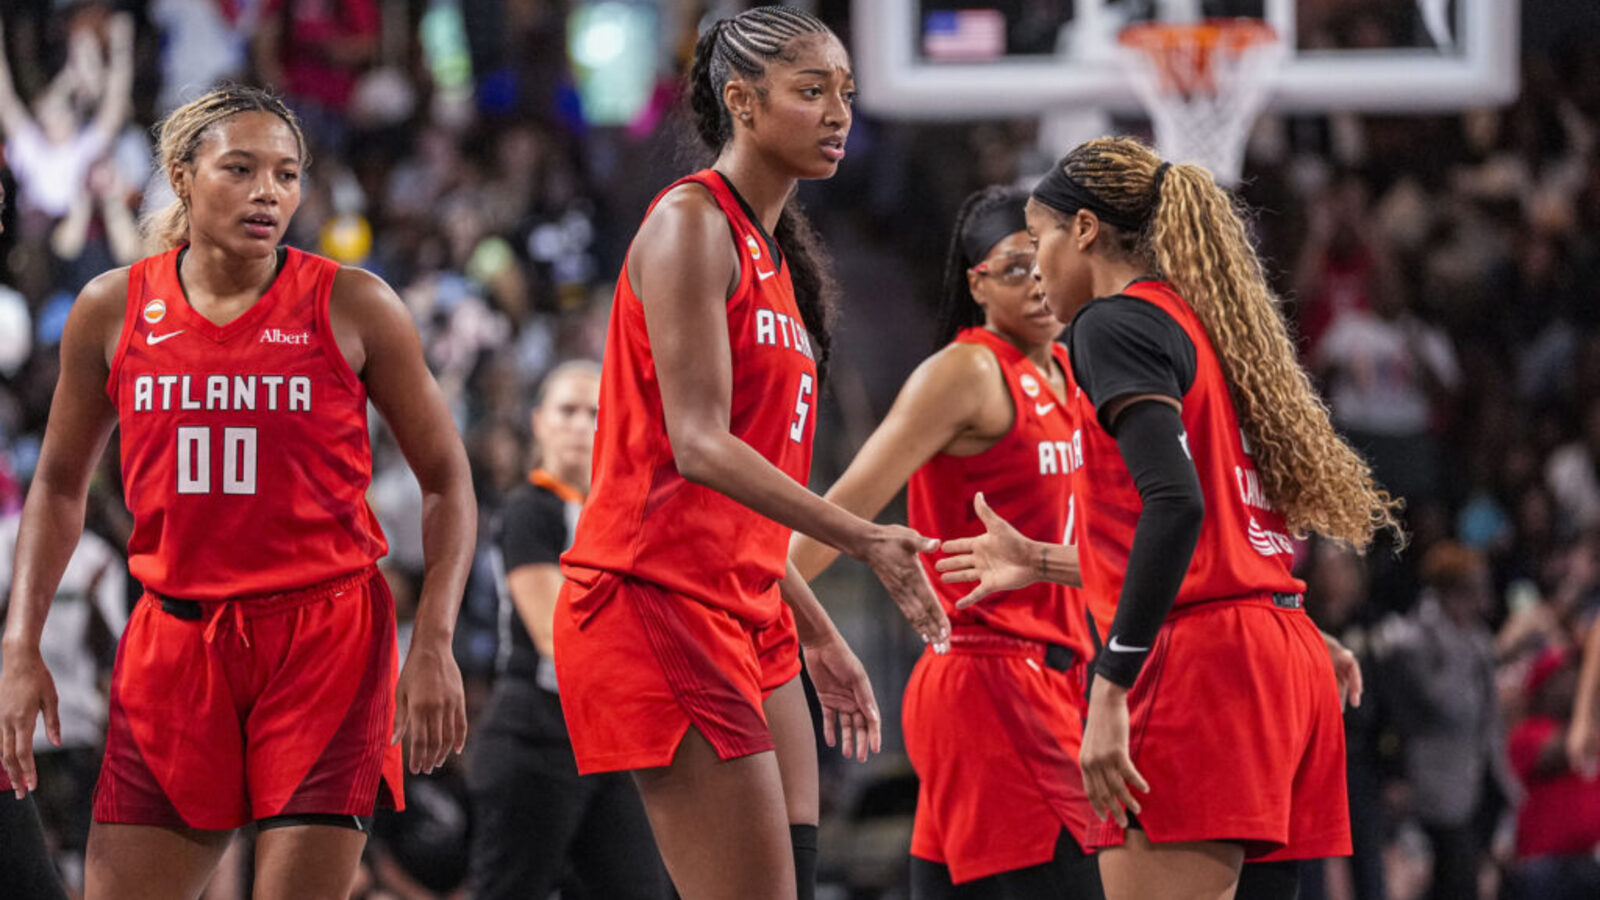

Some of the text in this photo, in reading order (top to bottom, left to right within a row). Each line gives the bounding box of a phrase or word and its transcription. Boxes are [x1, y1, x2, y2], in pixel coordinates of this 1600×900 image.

[259, 328, 310, 345] Albert
[134, 374, 312, 412] ATLANTA
[789, 372, 813, 444] 5
[176, 425, 258, 495] 00
